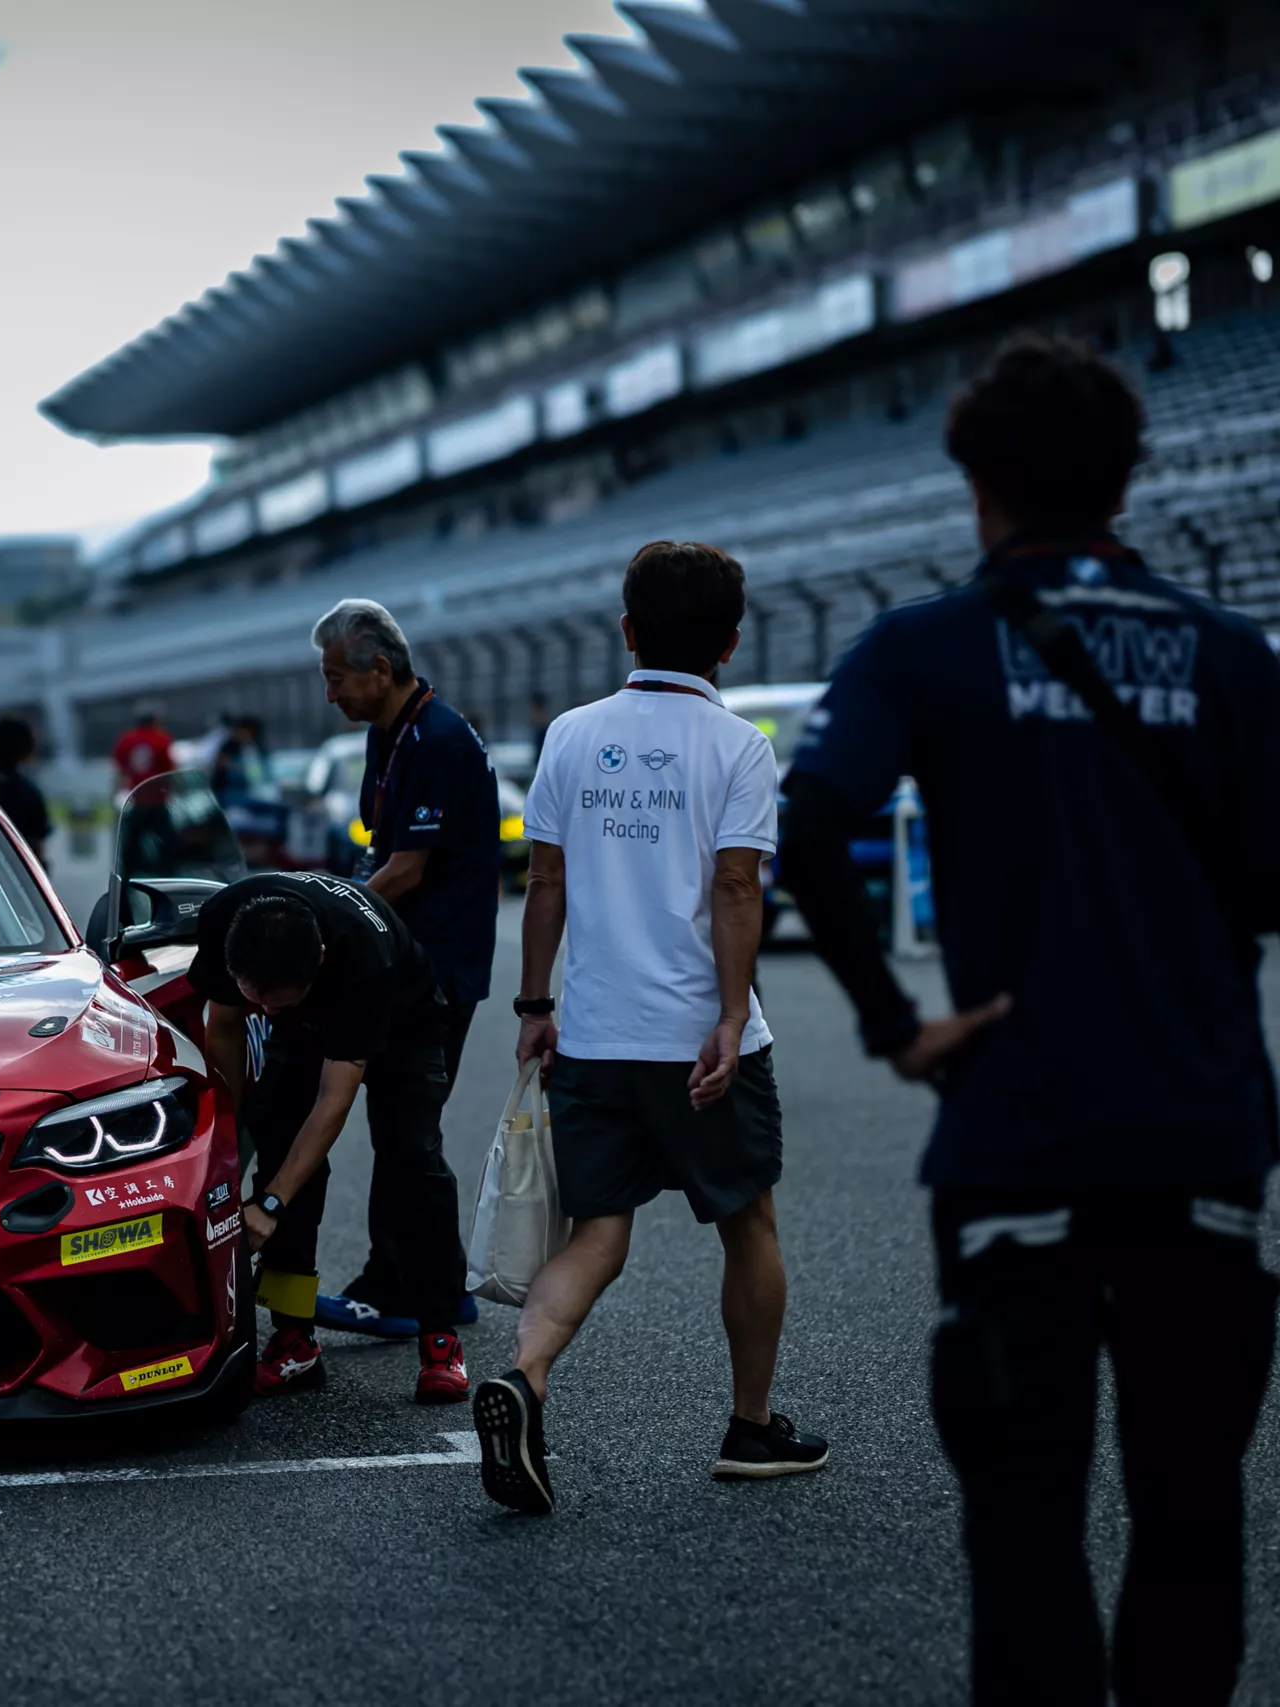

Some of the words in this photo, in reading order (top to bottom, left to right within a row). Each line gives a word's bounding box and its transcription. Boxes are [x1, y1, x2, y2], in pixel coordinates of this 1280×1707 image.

[994, 614, 1199, 685] MW
[582, 789, 624, 809] BMW
[630, 790, 643, 809] &
[648, 790, 686, 810] MINI
[603, 818, 660, 843] Racing
[275, 871, 388, 933] SHINS
[104, 1175, 176, 1200] 空調工房
[124, 1191, 165, 1209] Hokkaido
[70, 1220, 154, 1255] SHOWA
[138, 1363, 184, 1382] DUNLOP
